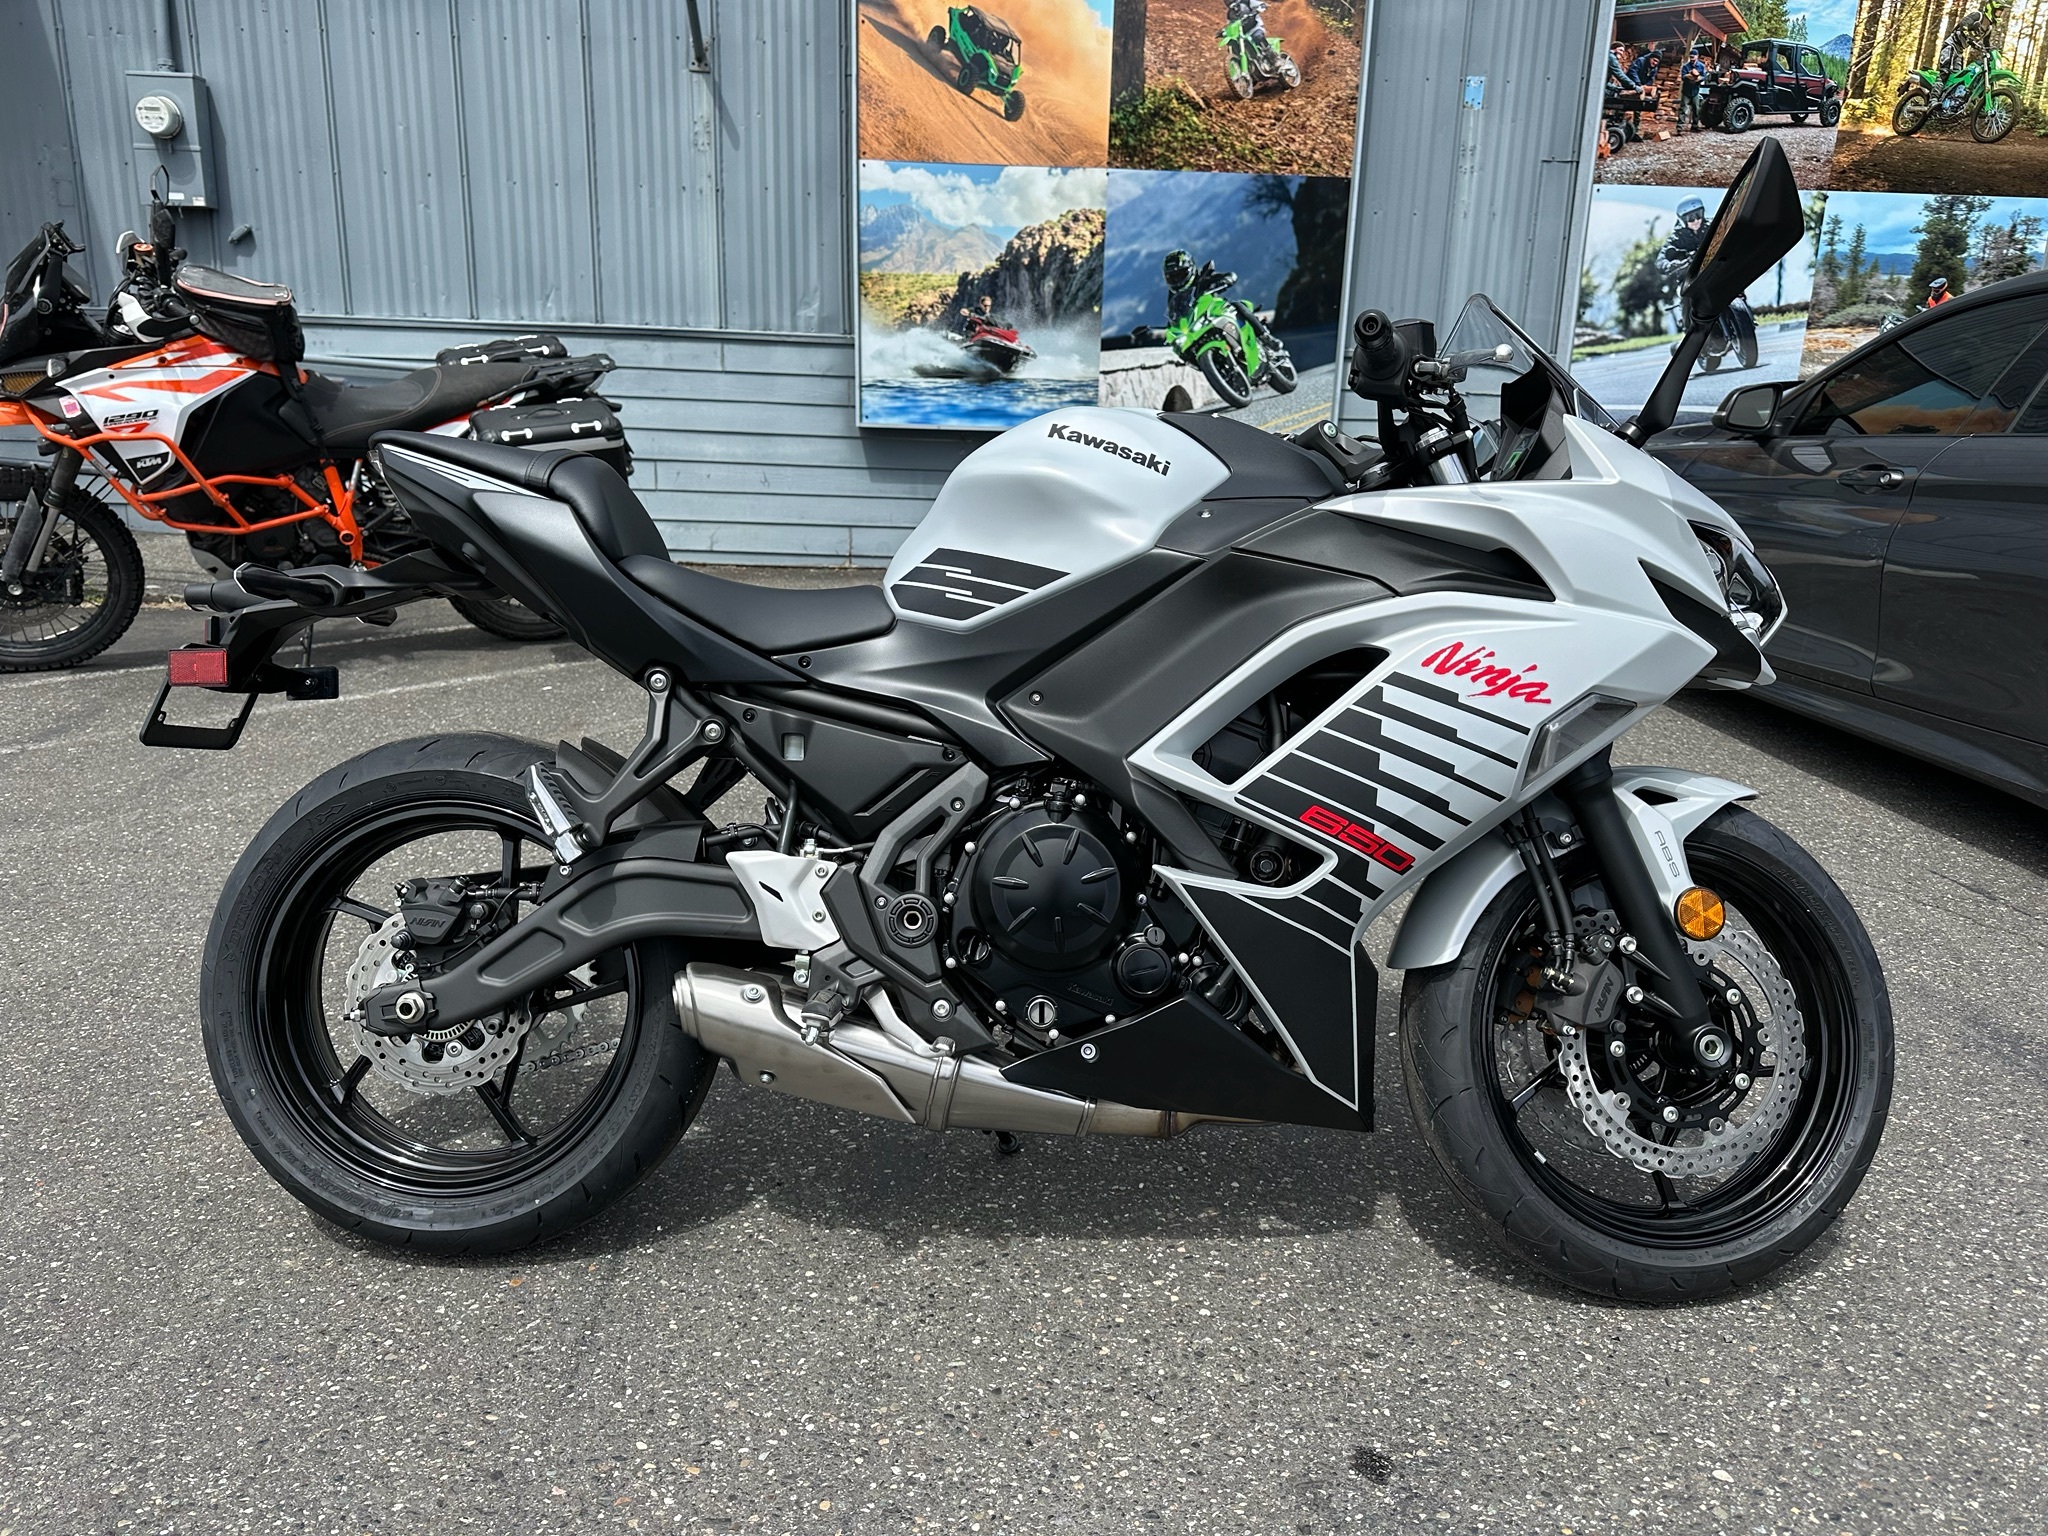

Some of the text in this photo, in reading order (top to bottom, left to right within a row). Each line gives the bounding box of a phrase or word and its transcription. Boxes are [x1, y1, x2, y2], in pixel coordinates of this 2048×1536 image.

[103, 409, 159, 424] 1290
[136, 457, 162, 469] KTM
[1047, 423, 1171, 477] Kawasaki
[1421, 641, 1552, 704] Ninja
[1299, 804, 1416, 876] 650
[1654, 830, 1680, 878] ABS
[227, 857, 277, 947] DUNLOP
